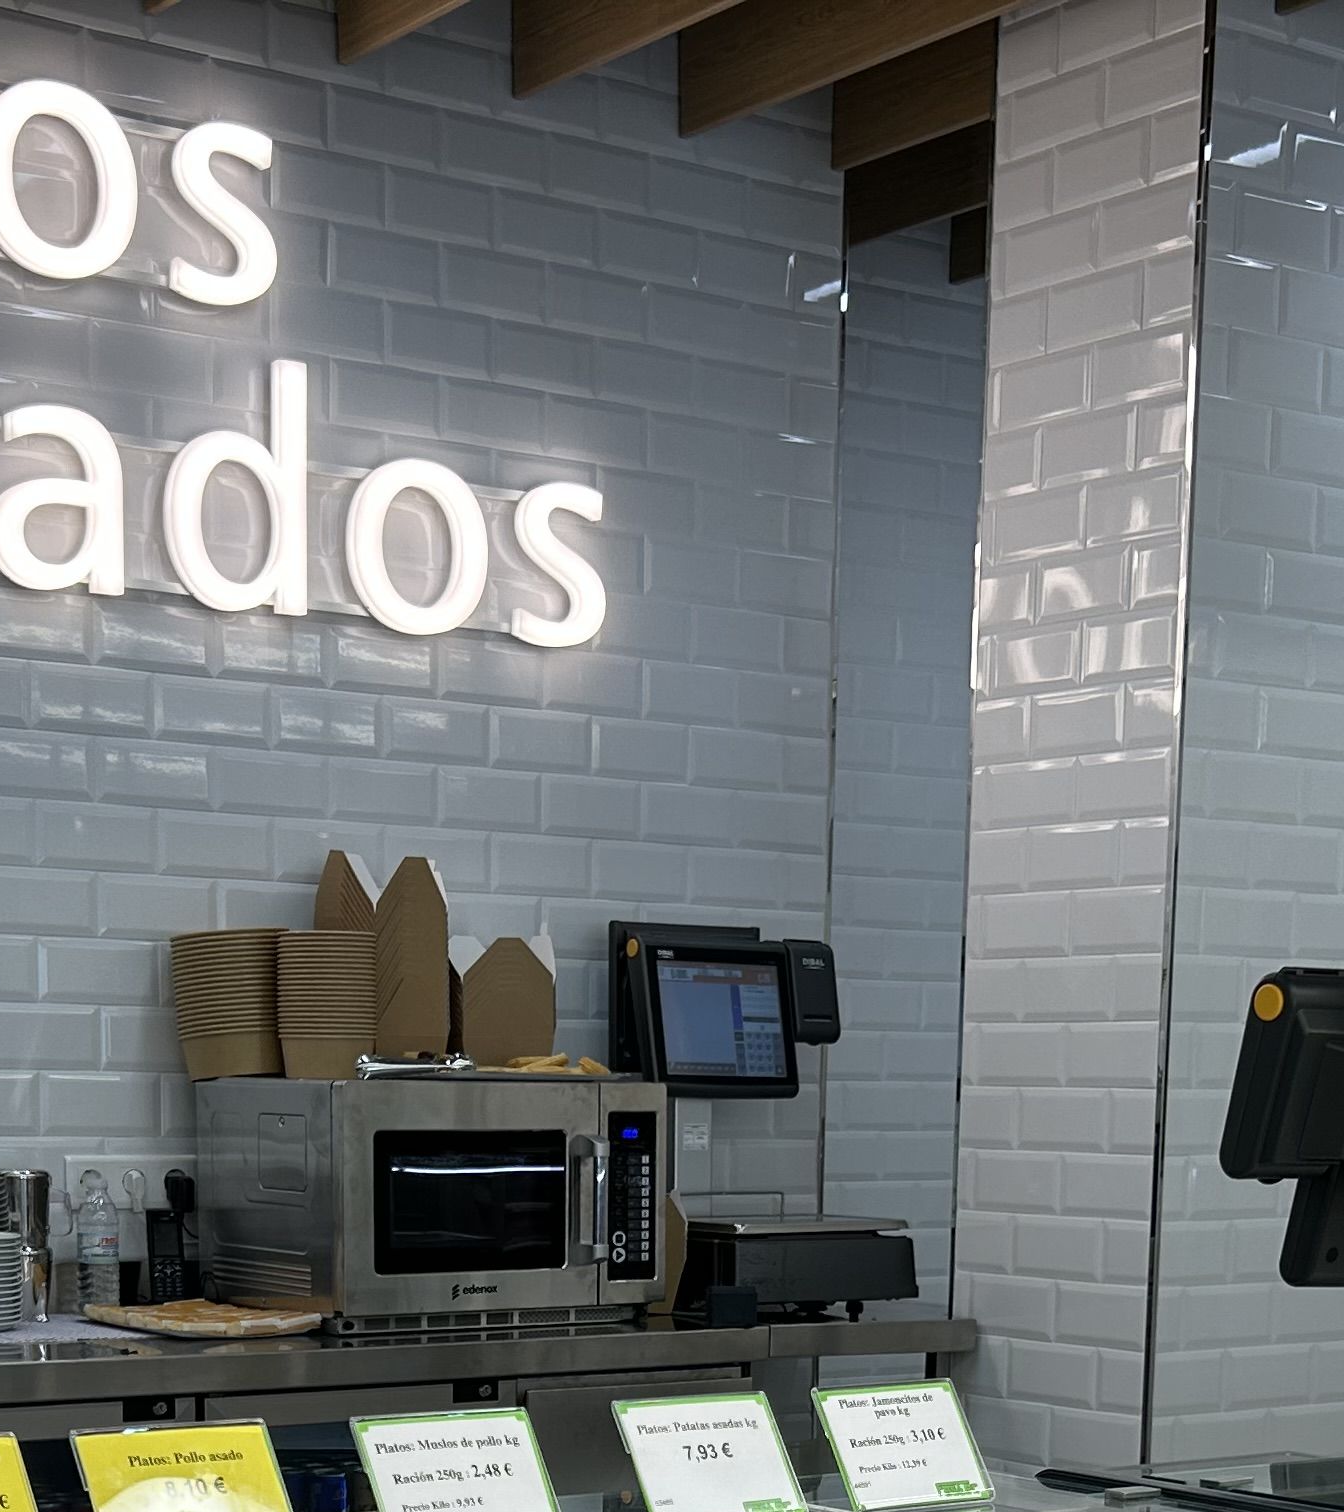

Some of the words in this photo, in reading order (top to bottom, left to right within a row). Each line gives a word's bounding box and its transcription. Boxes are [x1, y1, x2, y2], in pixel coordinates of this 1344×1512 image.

[463, 1284, 498, 1295] edenox
[374, 1442, 415, 1454] Platos:
[418, 1439, 458, 1451] Muslos
[461, 1437, 474, 1448] de
[476, 1436, 503, 1450] pollo
[505, 1435, 520, 1447] kg
[911, 1429, 935, 1444] 3,10
[128, 1454, 171, 1468] Platos:
[174, 1451, 206, 1465] Pollo
[209, 1449, 243, 1462] asado
[682, 1443, 718, 1463] 7,93
[722, 1442, 734, 1458] €
[393, 1472, 434, 1486] Ración
[437, 1469, 464, 1482] 250g
[472, 1463, 501, 1481] 2,48
[504, 1462, 514, 1477] €
[214, 1476, 227, 1495] €
[0, 1494, 10, 1510] €
[456, 1499, 475, 1510] 9,93
[478, 1497, 485, 1505] €
